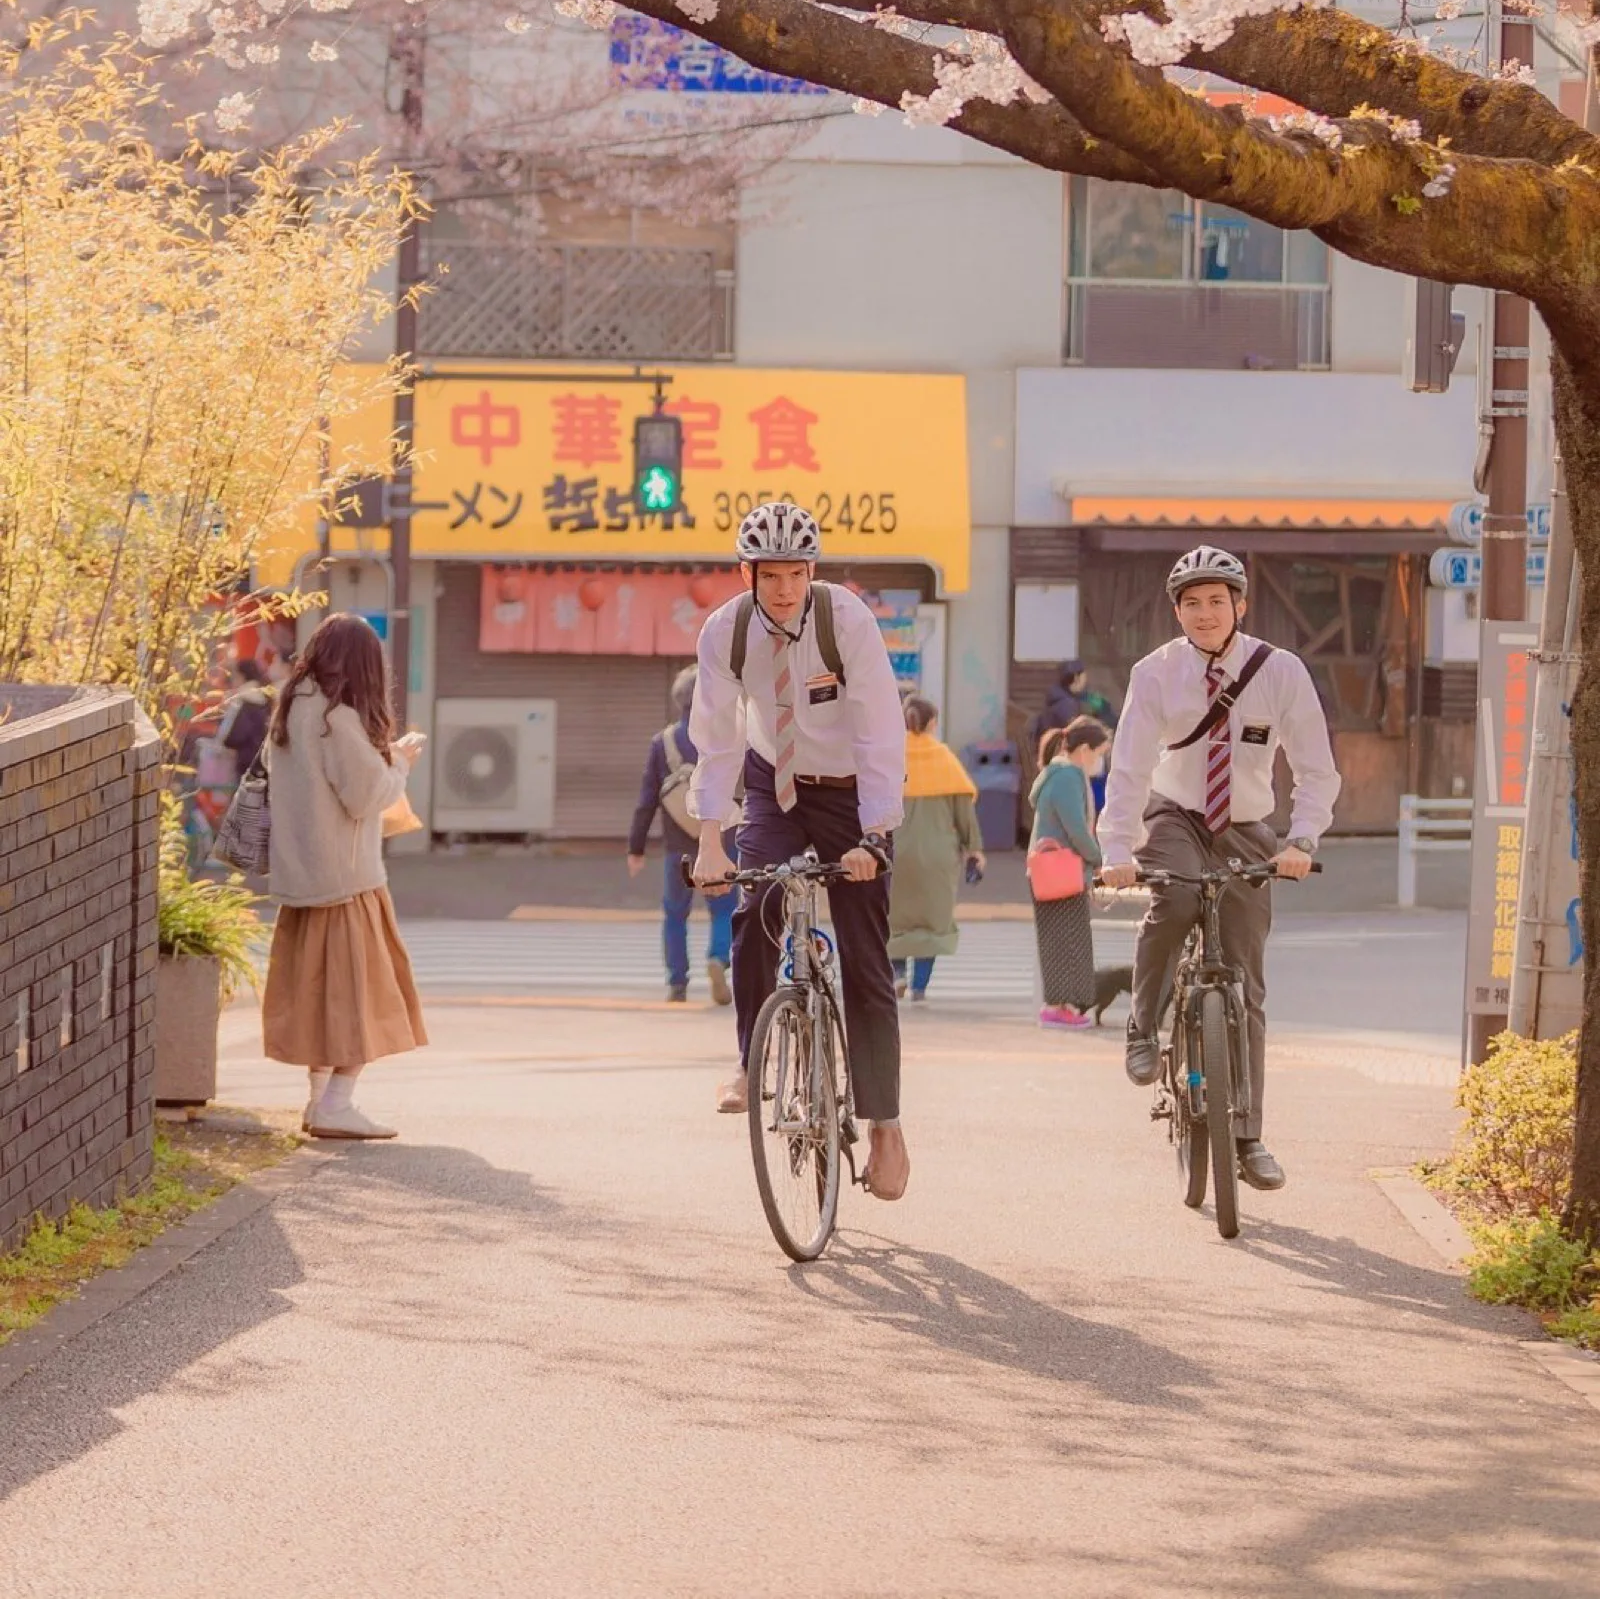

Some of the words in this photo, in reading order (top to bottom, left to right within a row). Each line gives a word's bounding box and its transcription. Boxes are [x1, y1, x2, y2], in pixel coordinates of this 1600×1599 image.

[451, 390, 820, 472] 中華定食
[411, 482, 521, 530] ーメン
[544, 475, 695, 532] 哲ち
[714, 491, 897, 533] 39-2425
